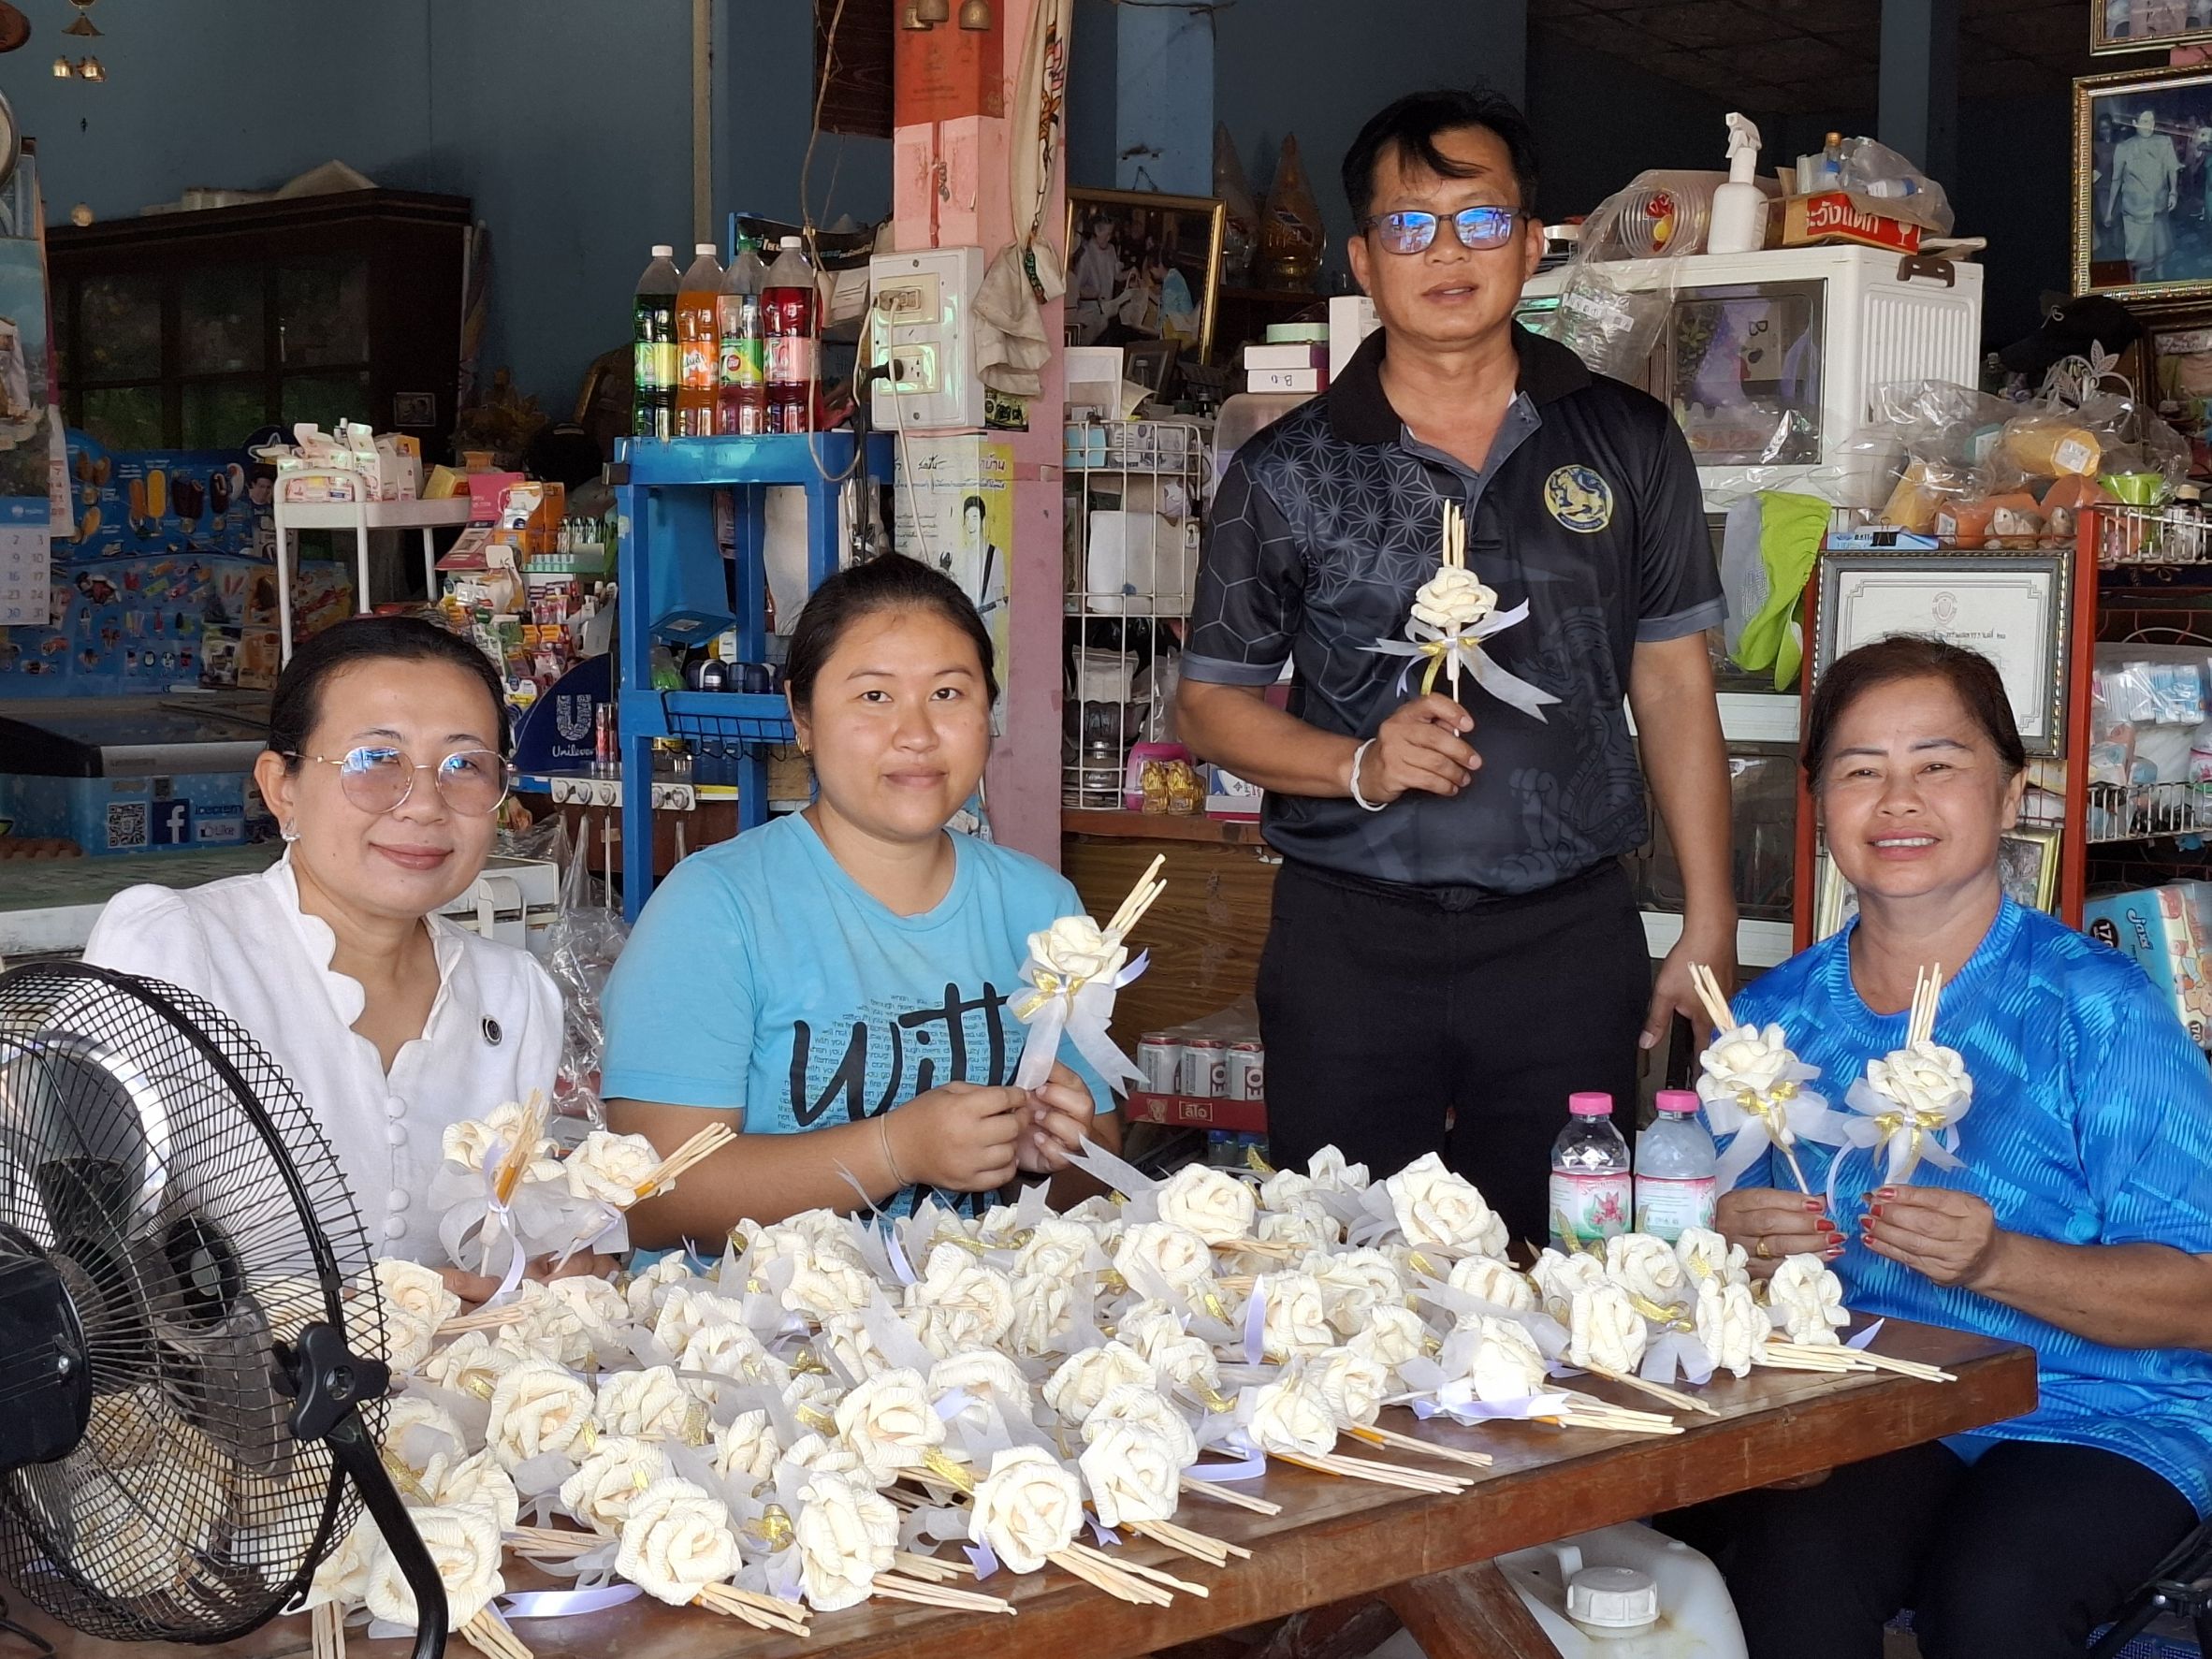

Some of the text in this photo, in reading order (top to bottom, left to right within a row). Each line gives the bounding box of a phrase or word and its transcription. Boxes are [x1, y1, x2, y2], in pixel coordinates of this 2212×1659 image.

[12, 553, 21, 563] 9
[8, 572, 44, 582] 16 17
